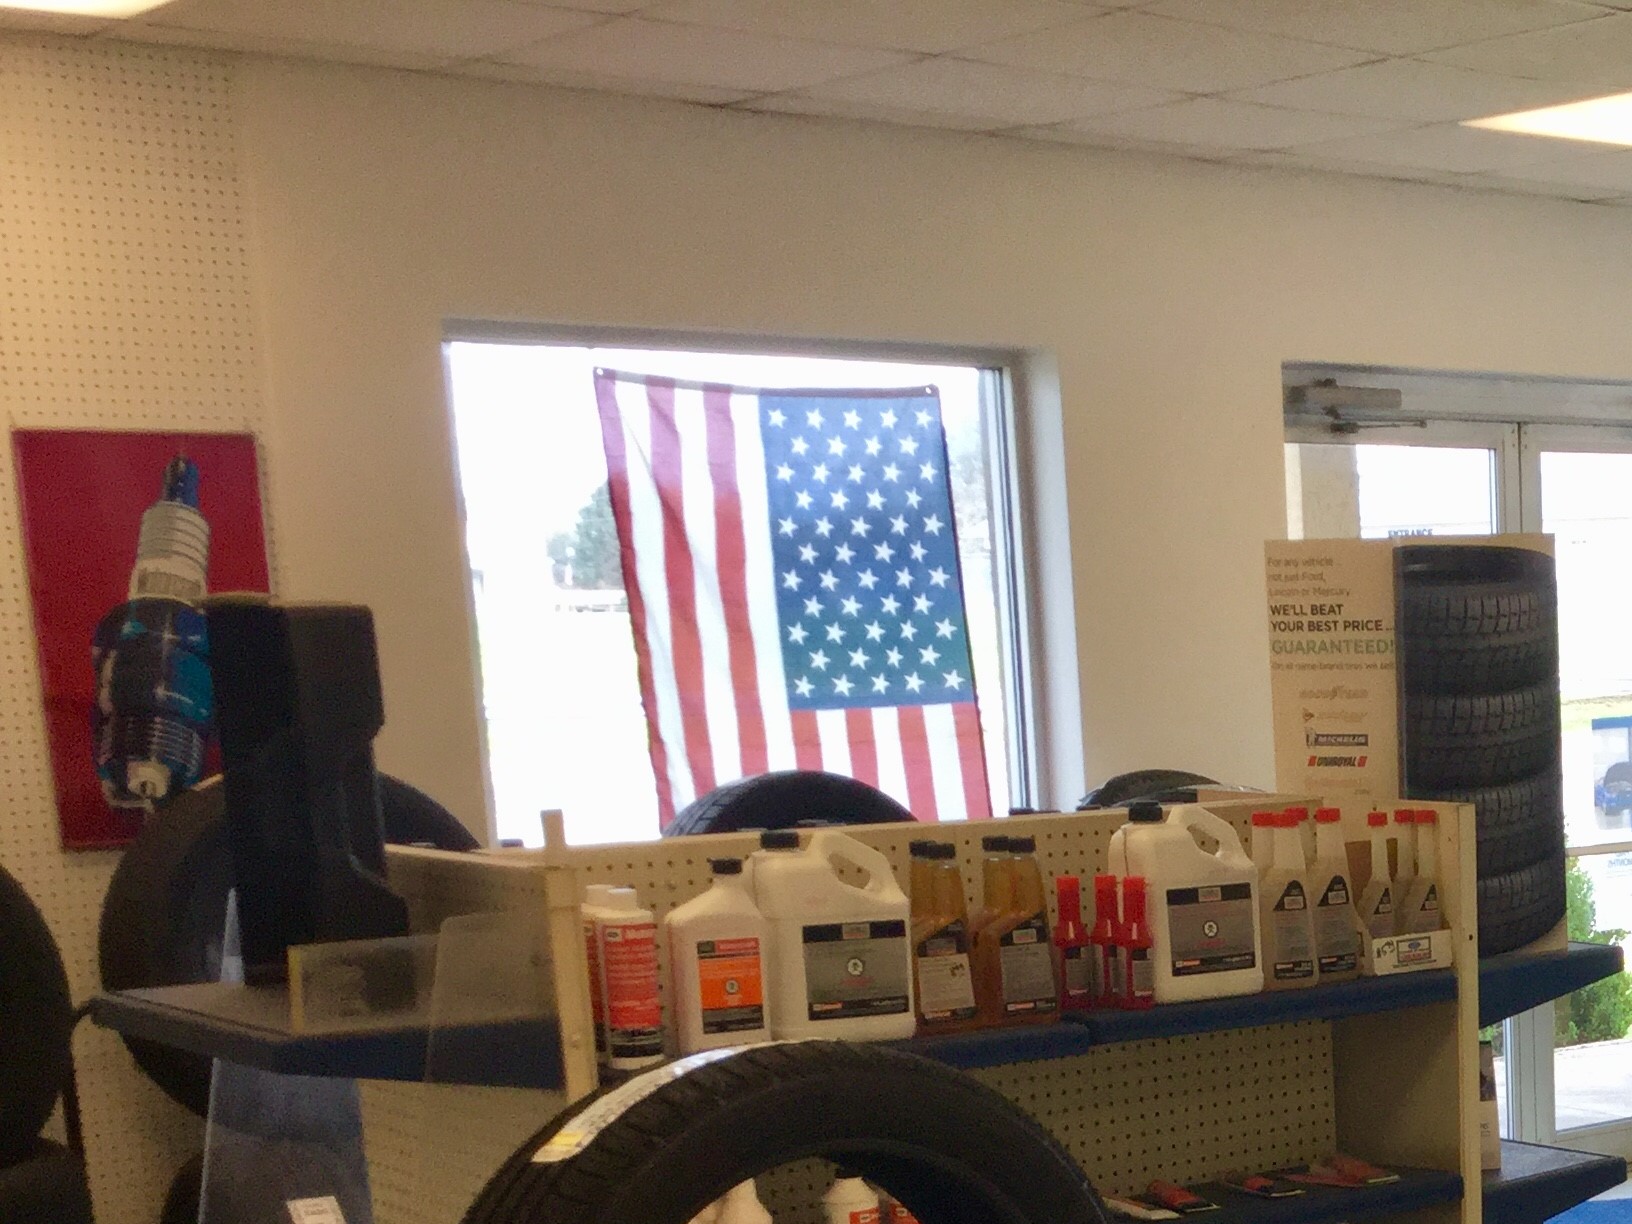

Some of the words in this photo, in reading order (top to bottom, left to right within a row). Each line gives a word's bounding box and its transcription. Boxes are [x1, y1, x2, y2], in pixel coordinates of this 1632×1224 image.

[1270, 604, 1308, 616] WE'LL
[1310, 603, 1344, 616] BEAT
[1270, 620, 1304, 632] YOUR
[1307, 620, 1339, 632] BEST
[1271, 638, 1395, 655] GUARANTEED!
